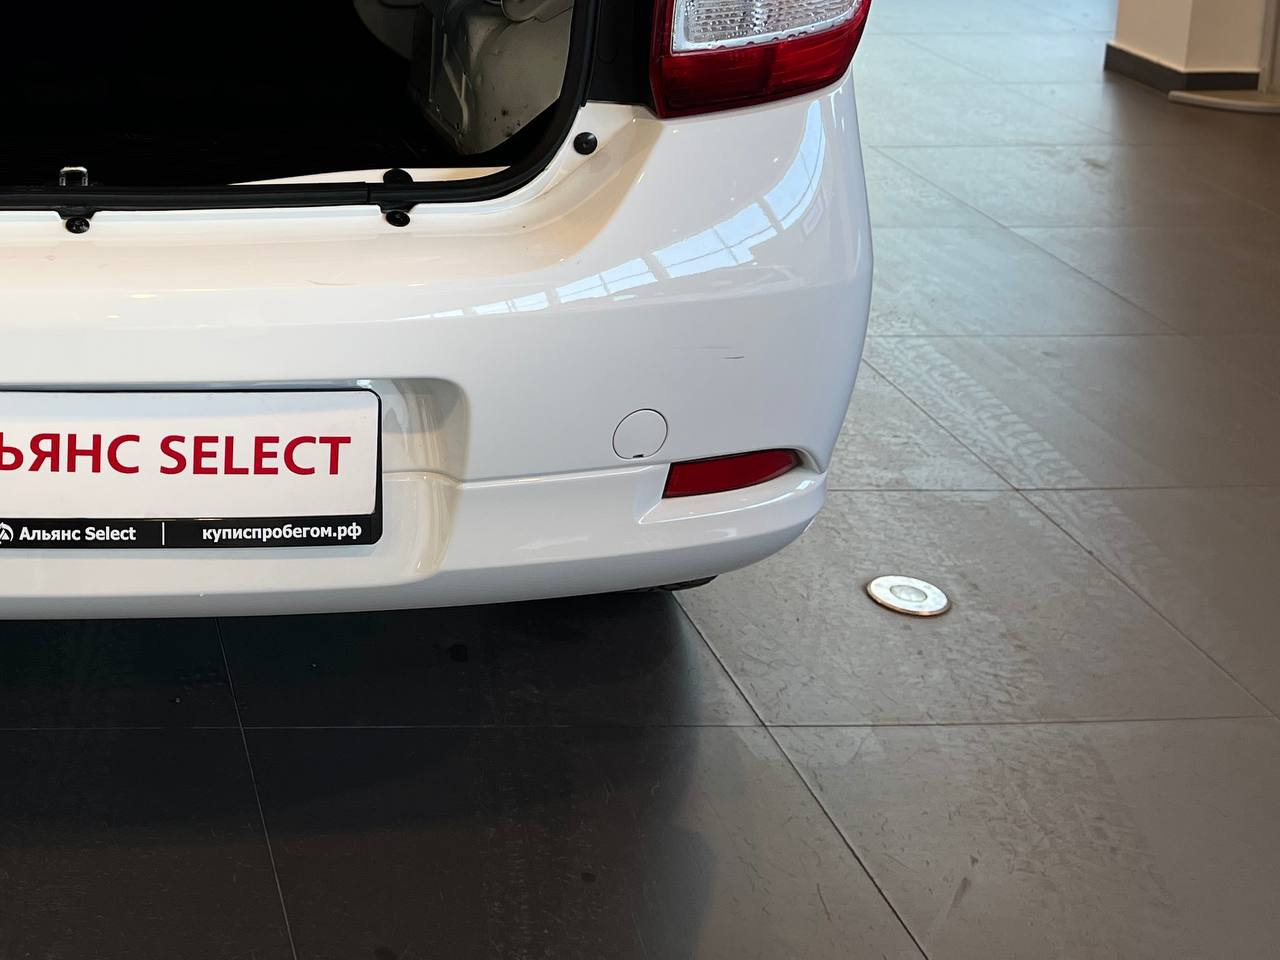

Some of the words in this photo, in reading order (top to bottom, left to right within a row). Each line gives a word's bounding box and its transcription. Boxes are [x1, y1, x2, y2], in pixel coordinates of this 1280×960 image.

[160, 435, 351, 475] SELECT
[18, 526, 81, 541] Альянс
[84, 525, 137, 541] Select
[202, 521, 362, 543] куписпробегом.рф
